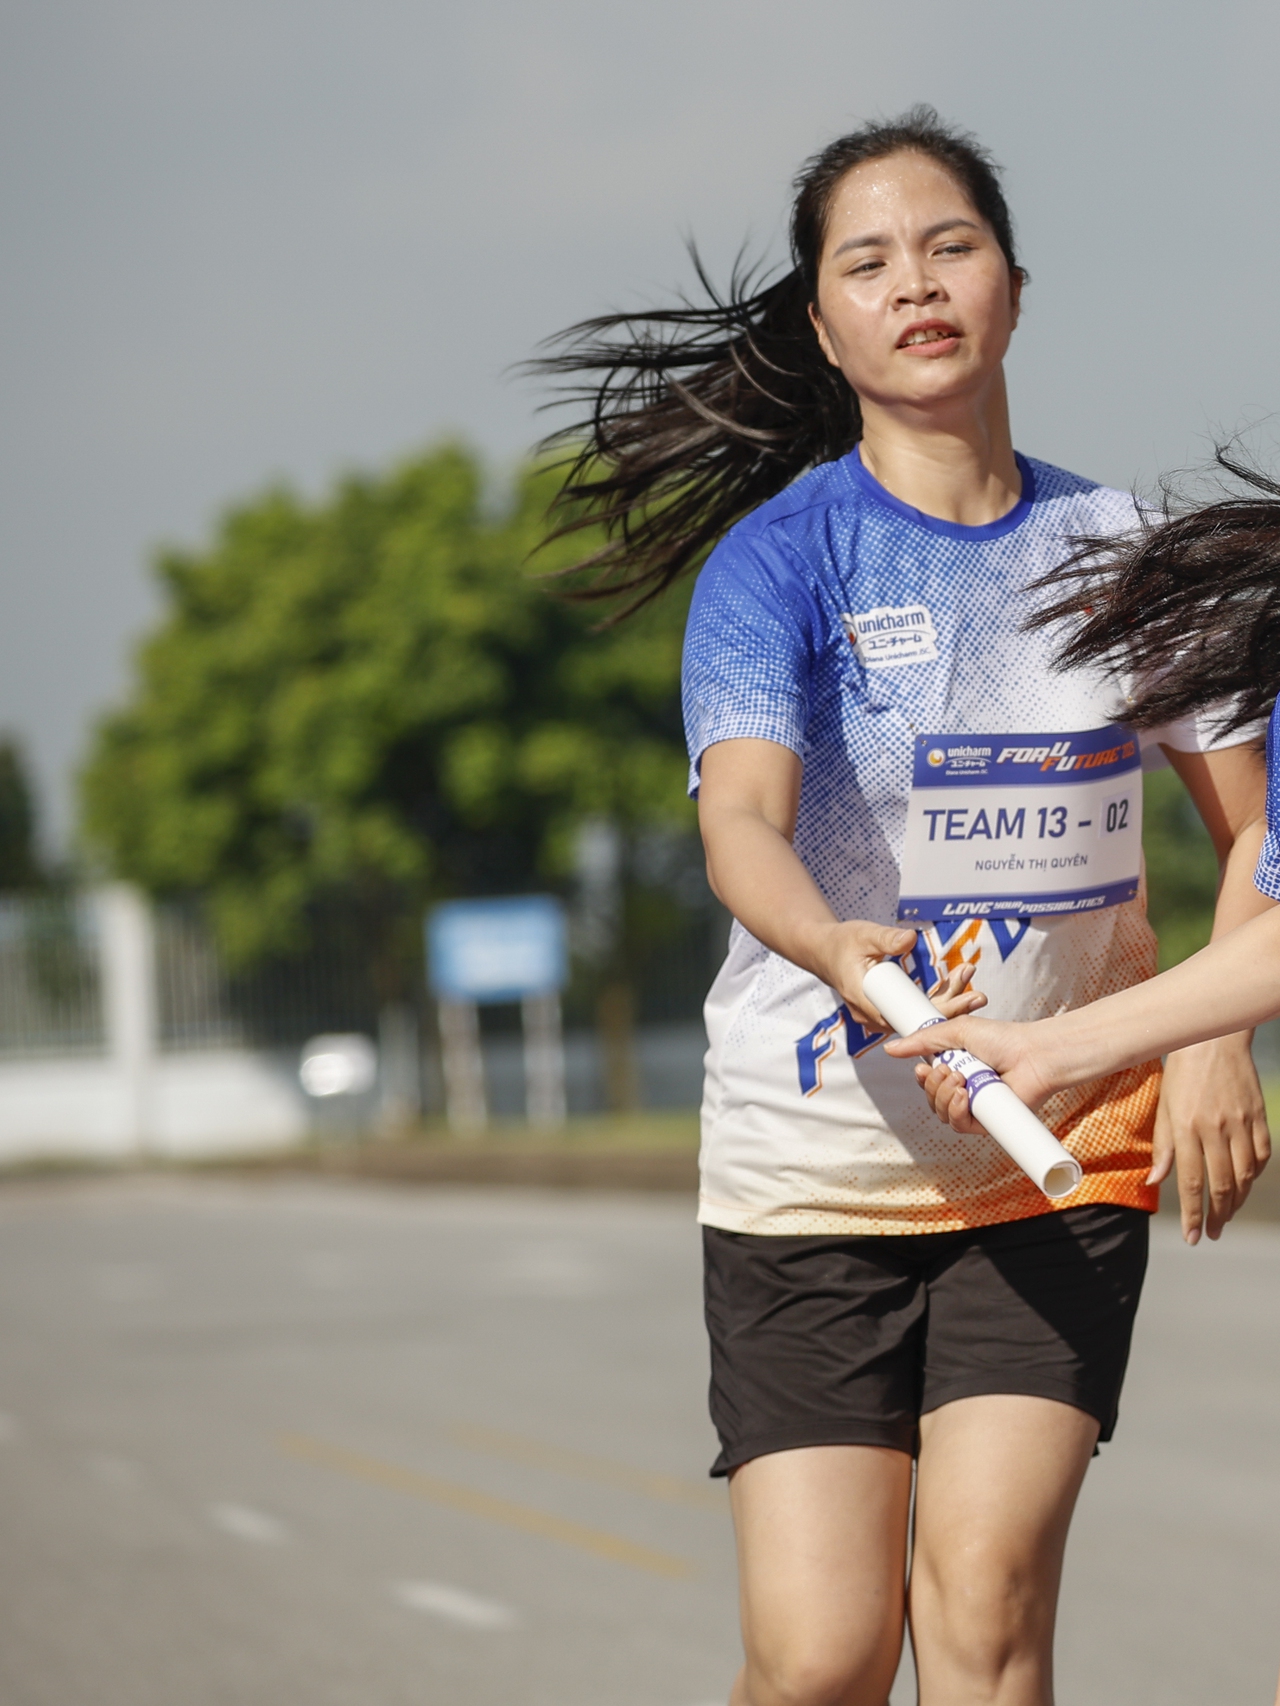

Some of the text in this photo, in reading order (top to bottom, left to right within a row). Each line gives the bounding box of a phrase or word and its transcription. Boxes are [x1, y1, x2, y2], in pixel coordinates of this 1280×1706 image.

[858, 611, 925, 633] unicharm
[947, 745, 992, 757] unicharm
[1040, 746, 1122, 772] FUTURE
[923, 807, 1026, 841] TEAM
[1037, 806, 1068, 839] 13
[1106, 799, 1129, 833] 02
[975, 853, 1088, 872] NGUYỄN THỊ QUYÊN
[942, 895, 1106, 916] LOVE YOUR POSSIBILITIES
